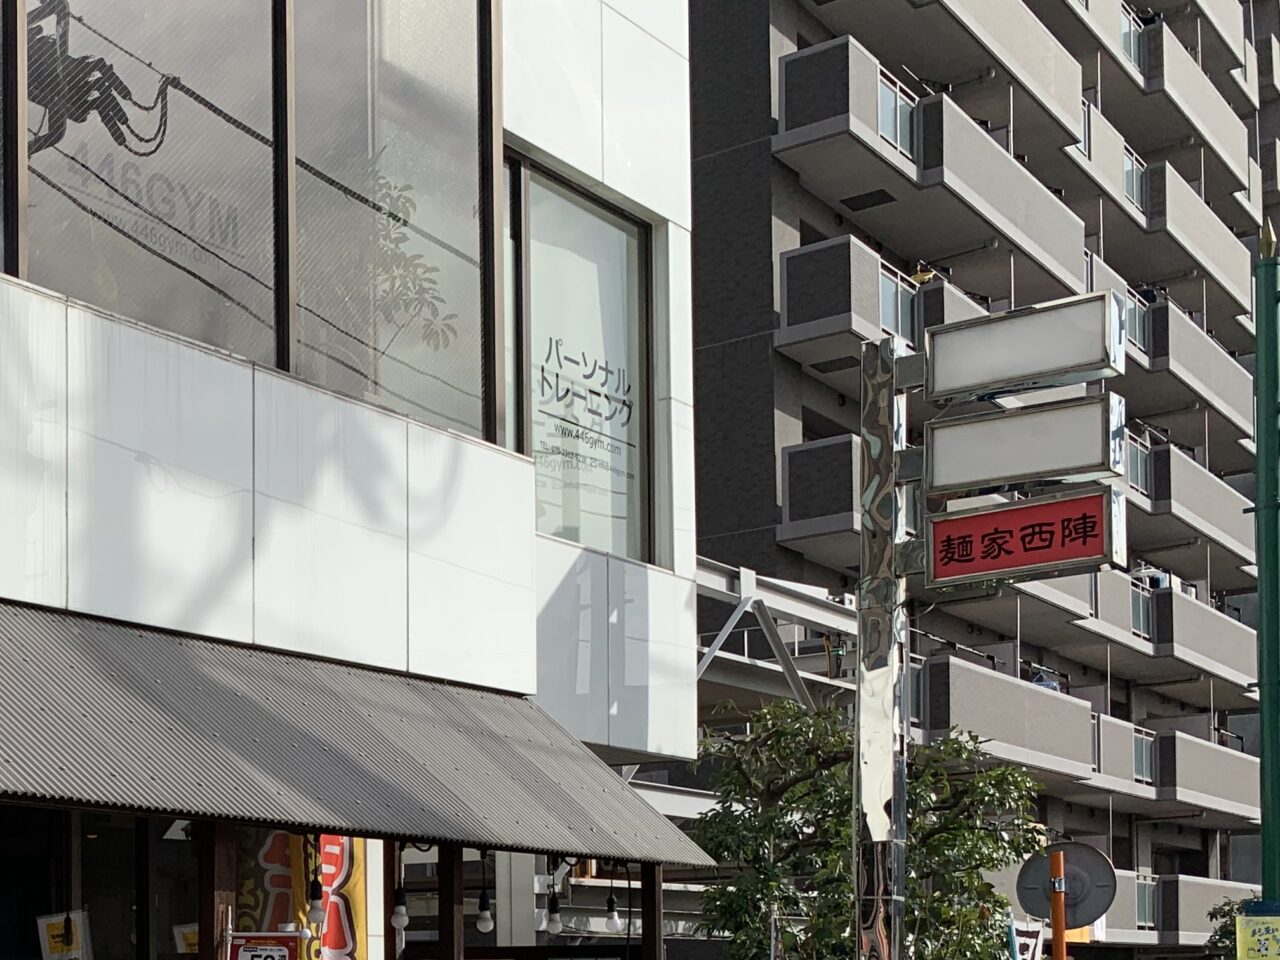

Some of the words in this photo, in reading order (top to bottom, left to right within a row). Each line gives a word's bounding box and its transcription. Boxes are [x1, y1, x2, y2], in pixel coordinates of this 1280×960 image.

[541, 365, 634, 428] トレーニング
[545, 336, 631, 397] パーソナル
[939, 513, 1099, 567] 麺家西陣
